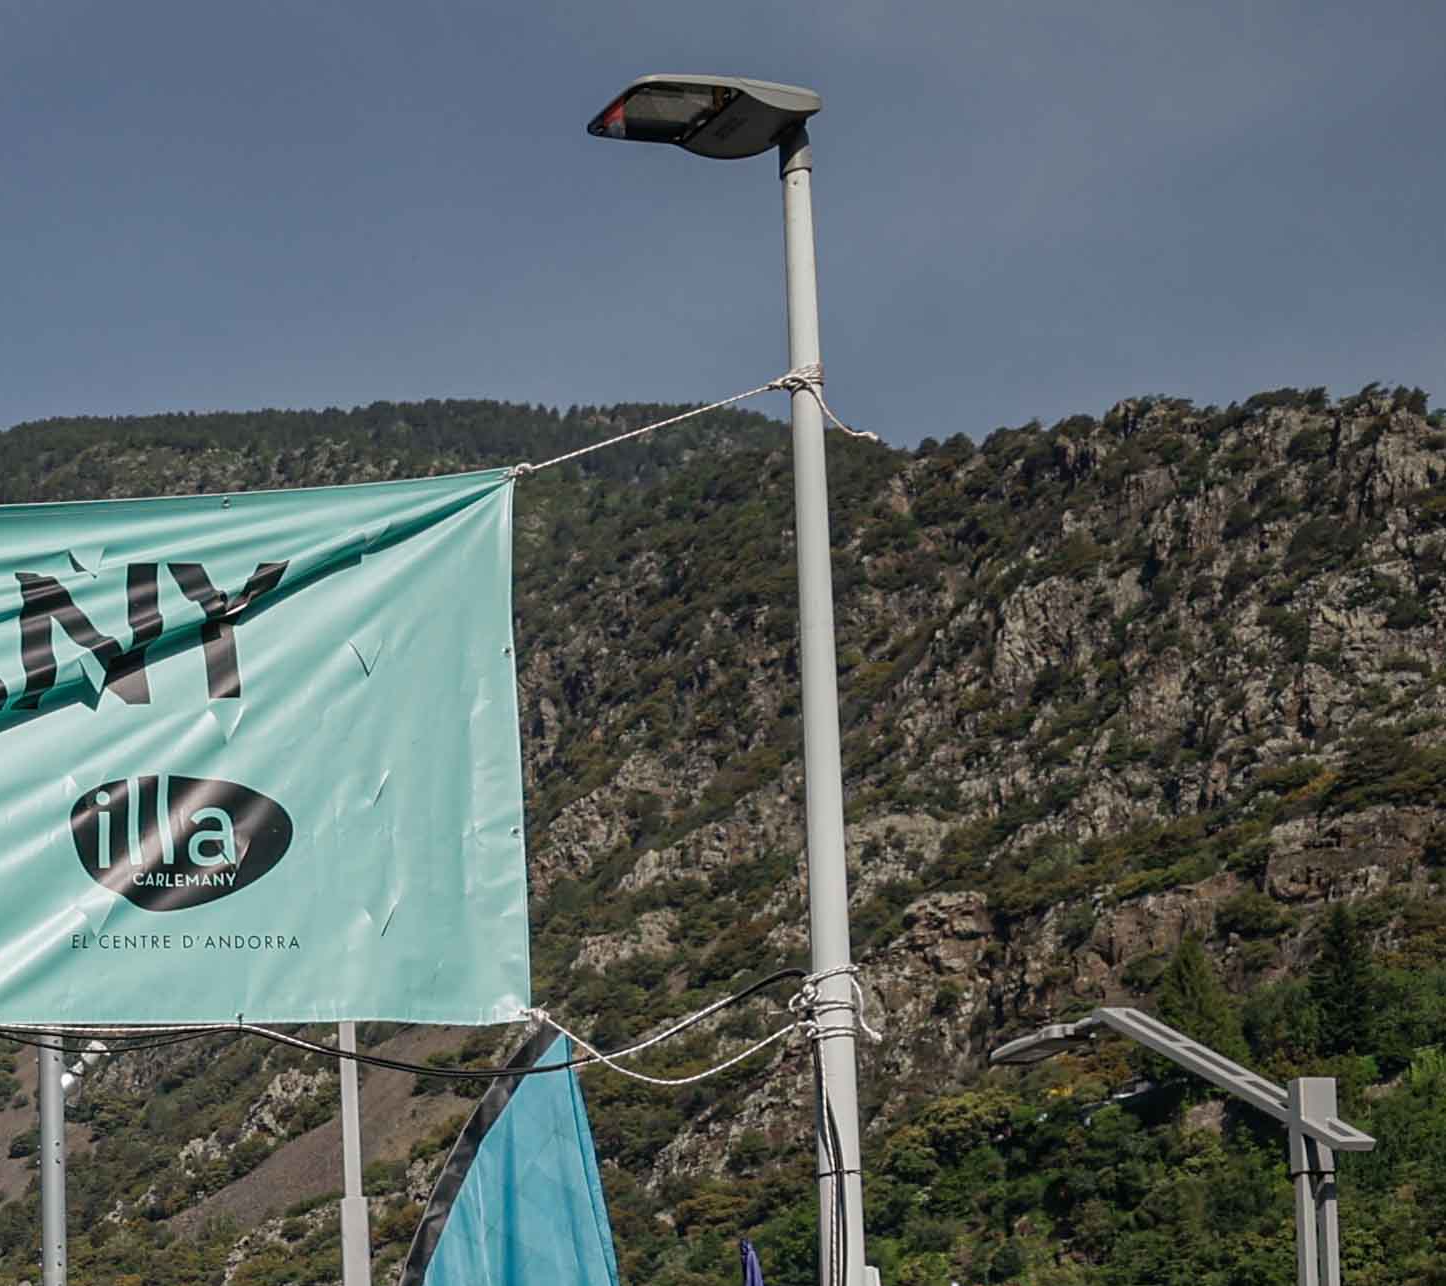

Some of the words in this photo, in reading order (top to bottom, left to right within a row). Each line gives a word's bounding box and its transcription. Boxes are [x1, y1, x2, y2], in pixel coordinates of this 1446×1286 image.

[96, 775, 239, 871] illa
[131, 872, 238, 888] CARLEMANY
[71, 934, 92, 950] EL
[98, 934, 173, 950] CENTRE
[182, 934, 302, 950] D'ANDORRA
